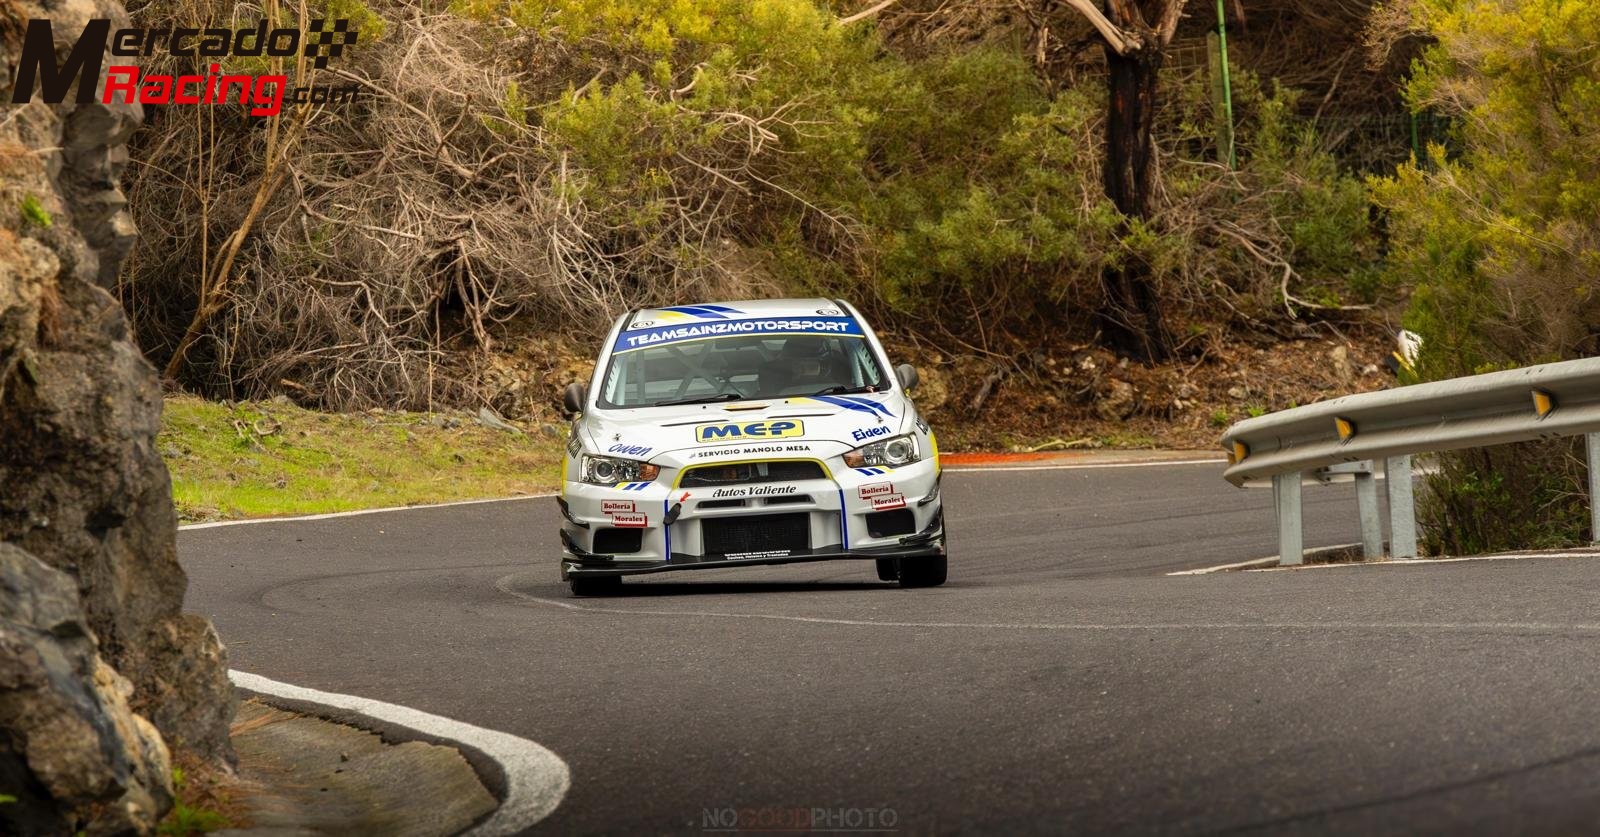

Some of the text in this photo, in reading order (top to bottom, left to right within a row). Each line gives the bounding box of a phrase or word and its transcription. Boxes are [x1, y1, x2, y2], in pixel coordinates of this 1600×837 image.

[627, 320, 849, 347] TEAMSAINZMOTORSPORT
[698, 448, 741, 458] SERVICIO
[743, 446, 783, 454] MANOLO
[712, 485, 797, 498] Autos Valiente
